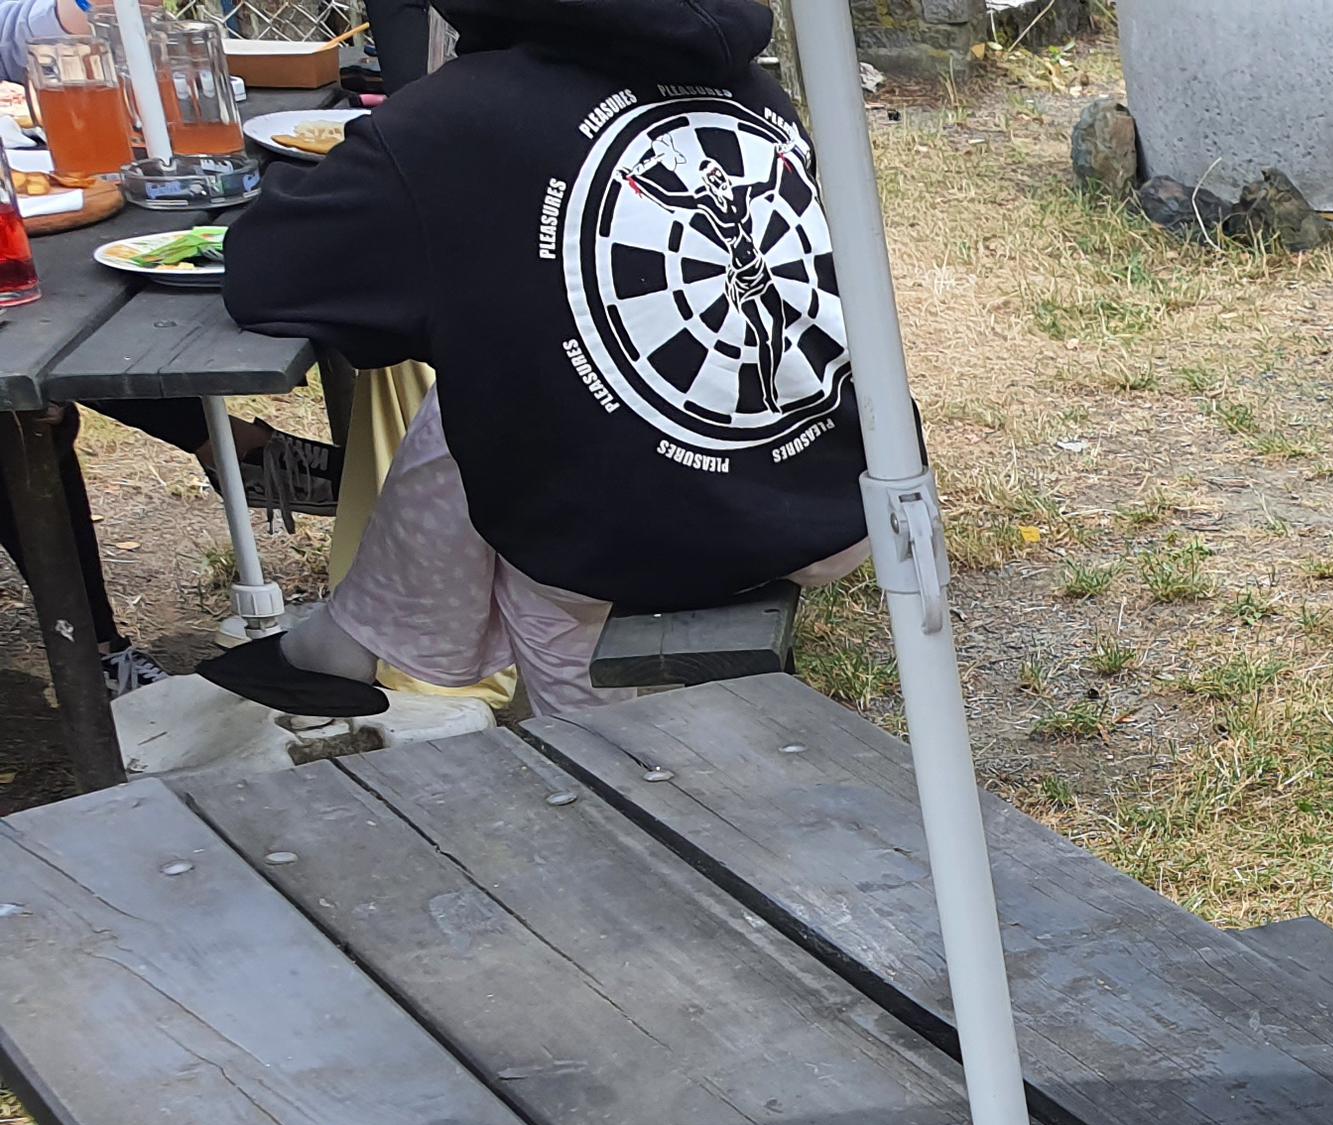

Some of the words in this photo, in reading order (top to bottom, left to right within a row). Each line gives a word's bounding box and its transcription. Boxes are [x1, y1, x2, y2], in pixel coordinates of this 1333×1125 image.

[578, 88, 638, 139] PLEASURES
[656, 84, 734, 99] PLEASURES
[538, 178, 568, 260] PLEASURES
[562, 338, 620, 414] PLEASURES
[656, 439, 730, 473] PLEASURES
[772, 418, 836, 463] PLEASURES
